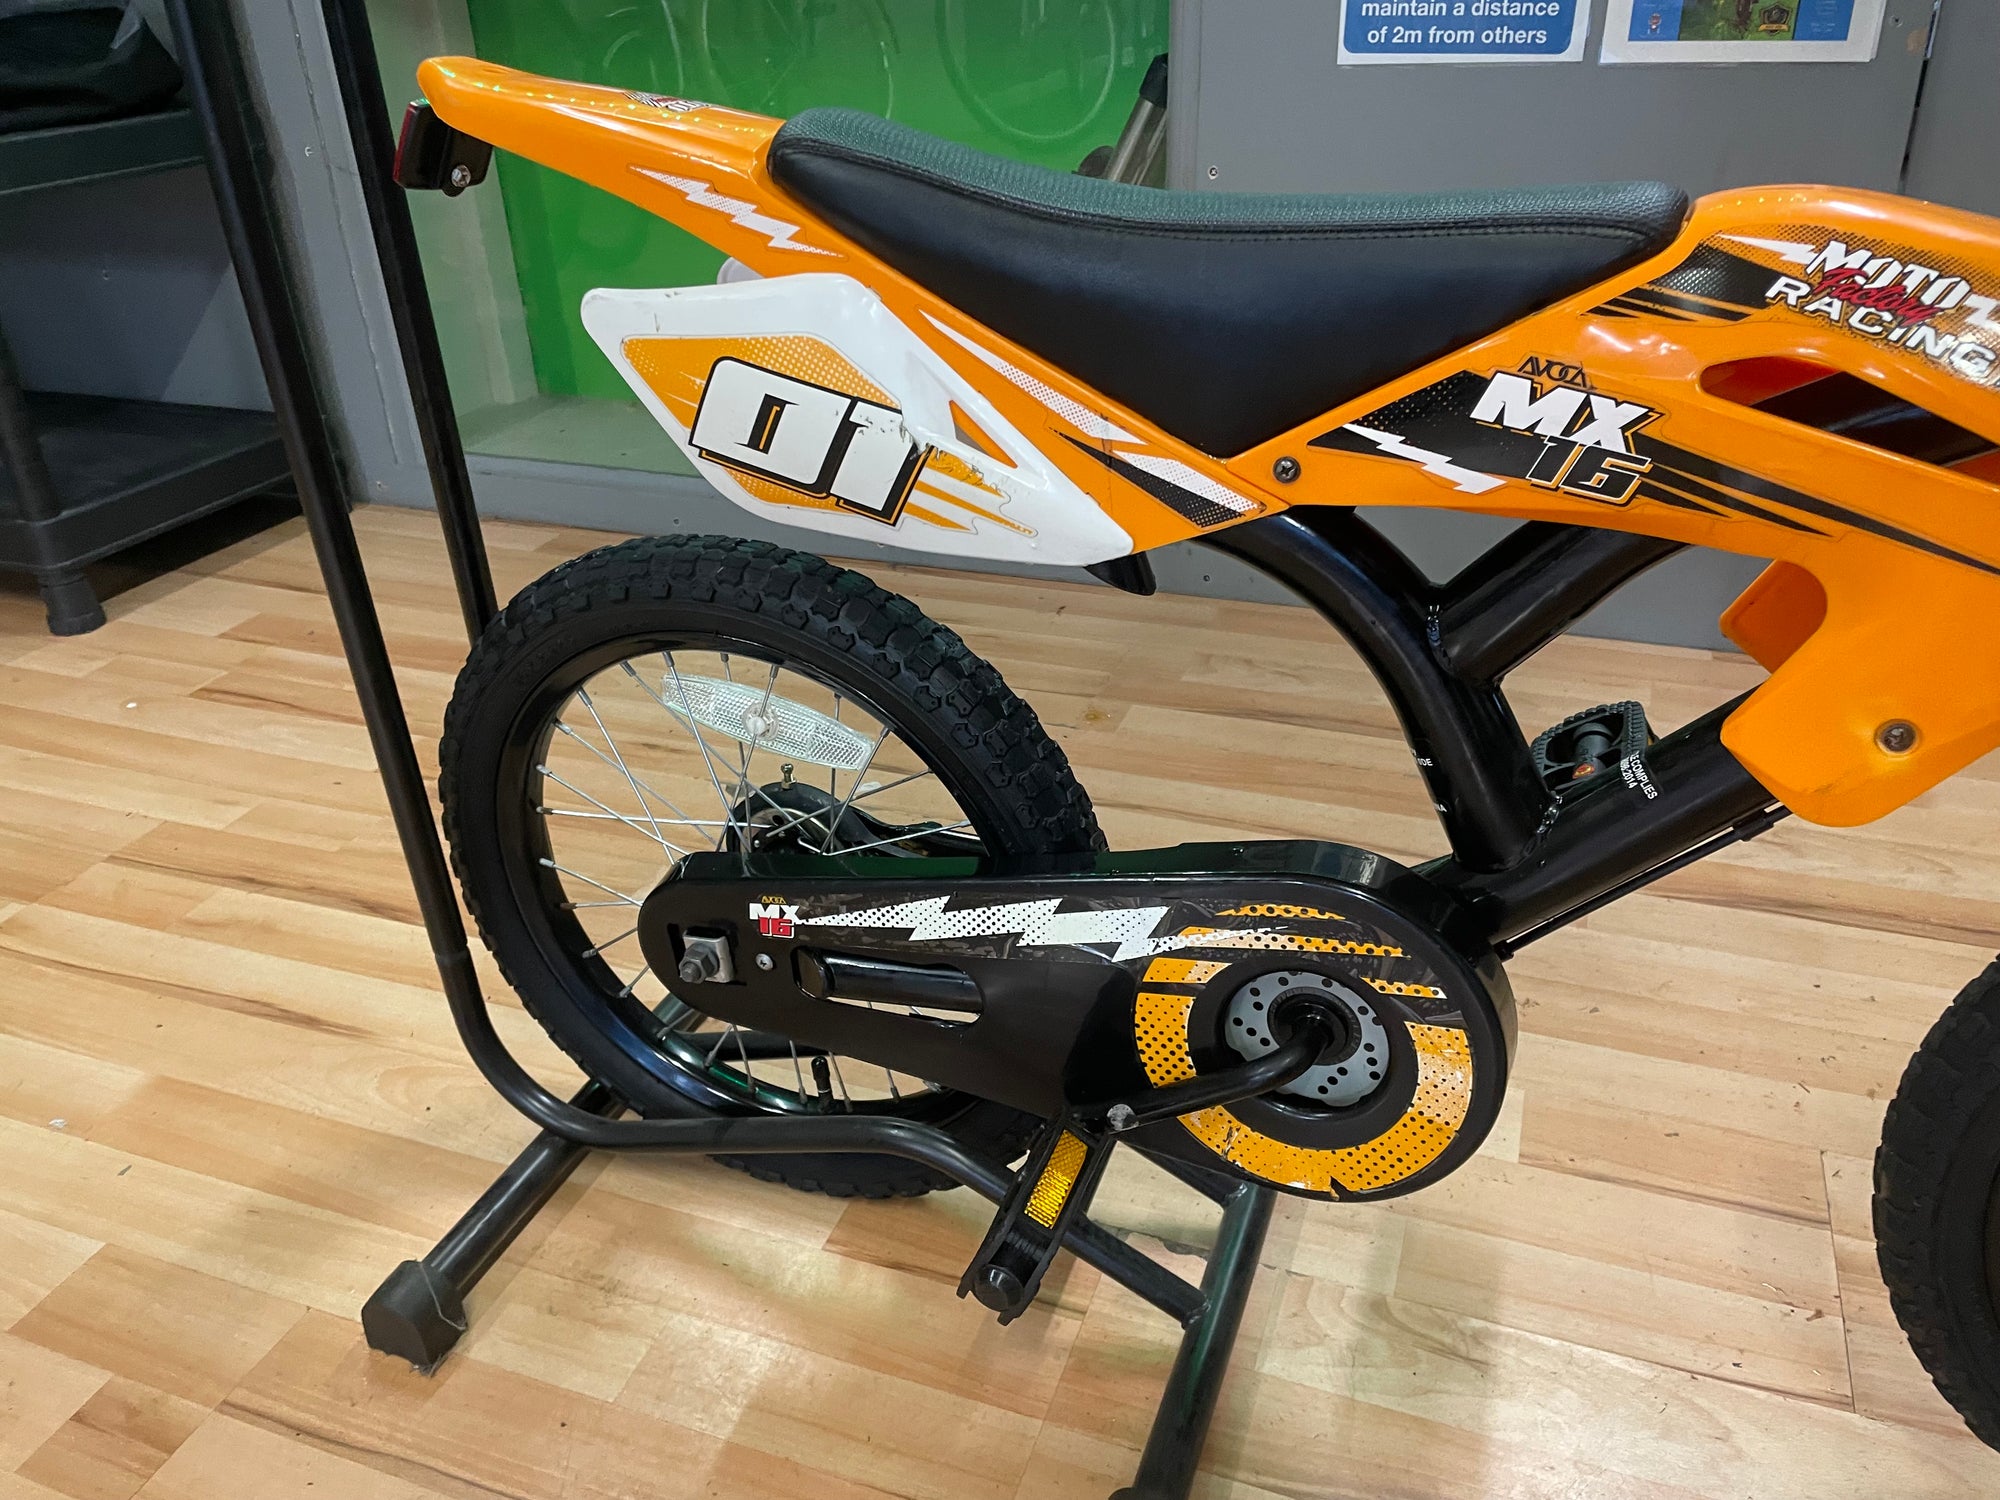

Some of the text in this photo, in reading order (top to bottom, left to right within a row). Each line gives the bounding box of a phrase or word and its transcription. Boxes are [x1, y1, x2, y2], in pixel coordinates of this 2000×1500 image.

[1361, 0, 1560, 16] maintain a distance
[1367, 25, 1548, 44] of 2m from others
[1804, 239, 1972, 309] MOTO
[1764, 275, 1997, 379] RACING
[1469, 371, 1658, 455] MX
[1525, 434, 1653, 507] 16
[748, 902, 801, 923] MX
[757, 916, 795, 939] 16
